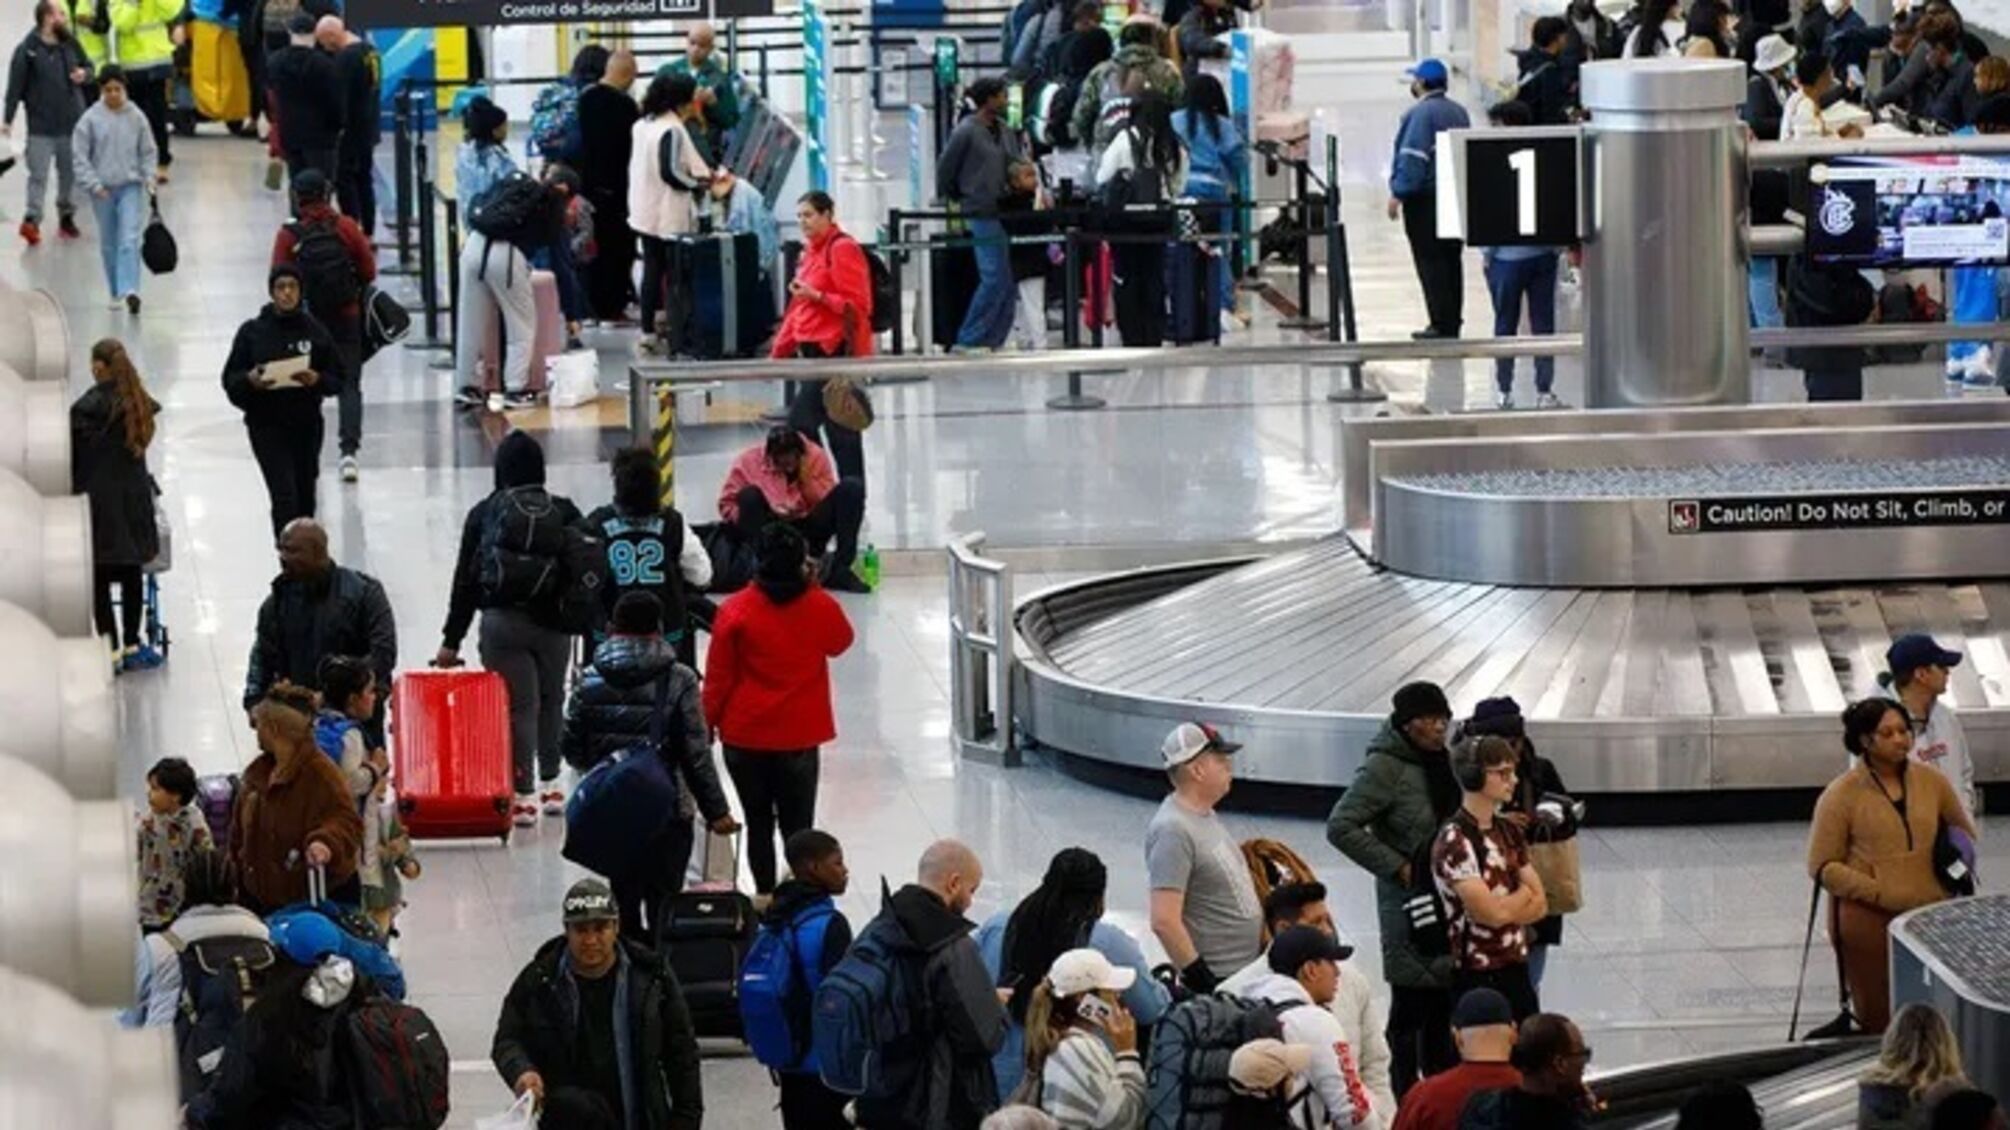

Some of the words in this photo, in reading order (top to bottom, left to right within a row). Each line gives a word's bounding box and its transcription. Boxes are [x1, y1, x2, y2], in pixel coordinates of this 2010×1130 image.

[500, 2, 556, 18] Control
[559, 1, 578, 17] de
[582, 0, 657, 17] Seguridad
[1508, 148, 1537, 236] 1
[1706, 502, 1793, 524] Caution!
[1799, 502, 1827, 521] Do
[1832, 501, 1870, 520] Not
[1875, 499, 1908, 520] Sit,
[1913, 498, 1978, 520] Climb,
[1983, 500, 2004, 517] or
[608, 538, 665, 586] 82
